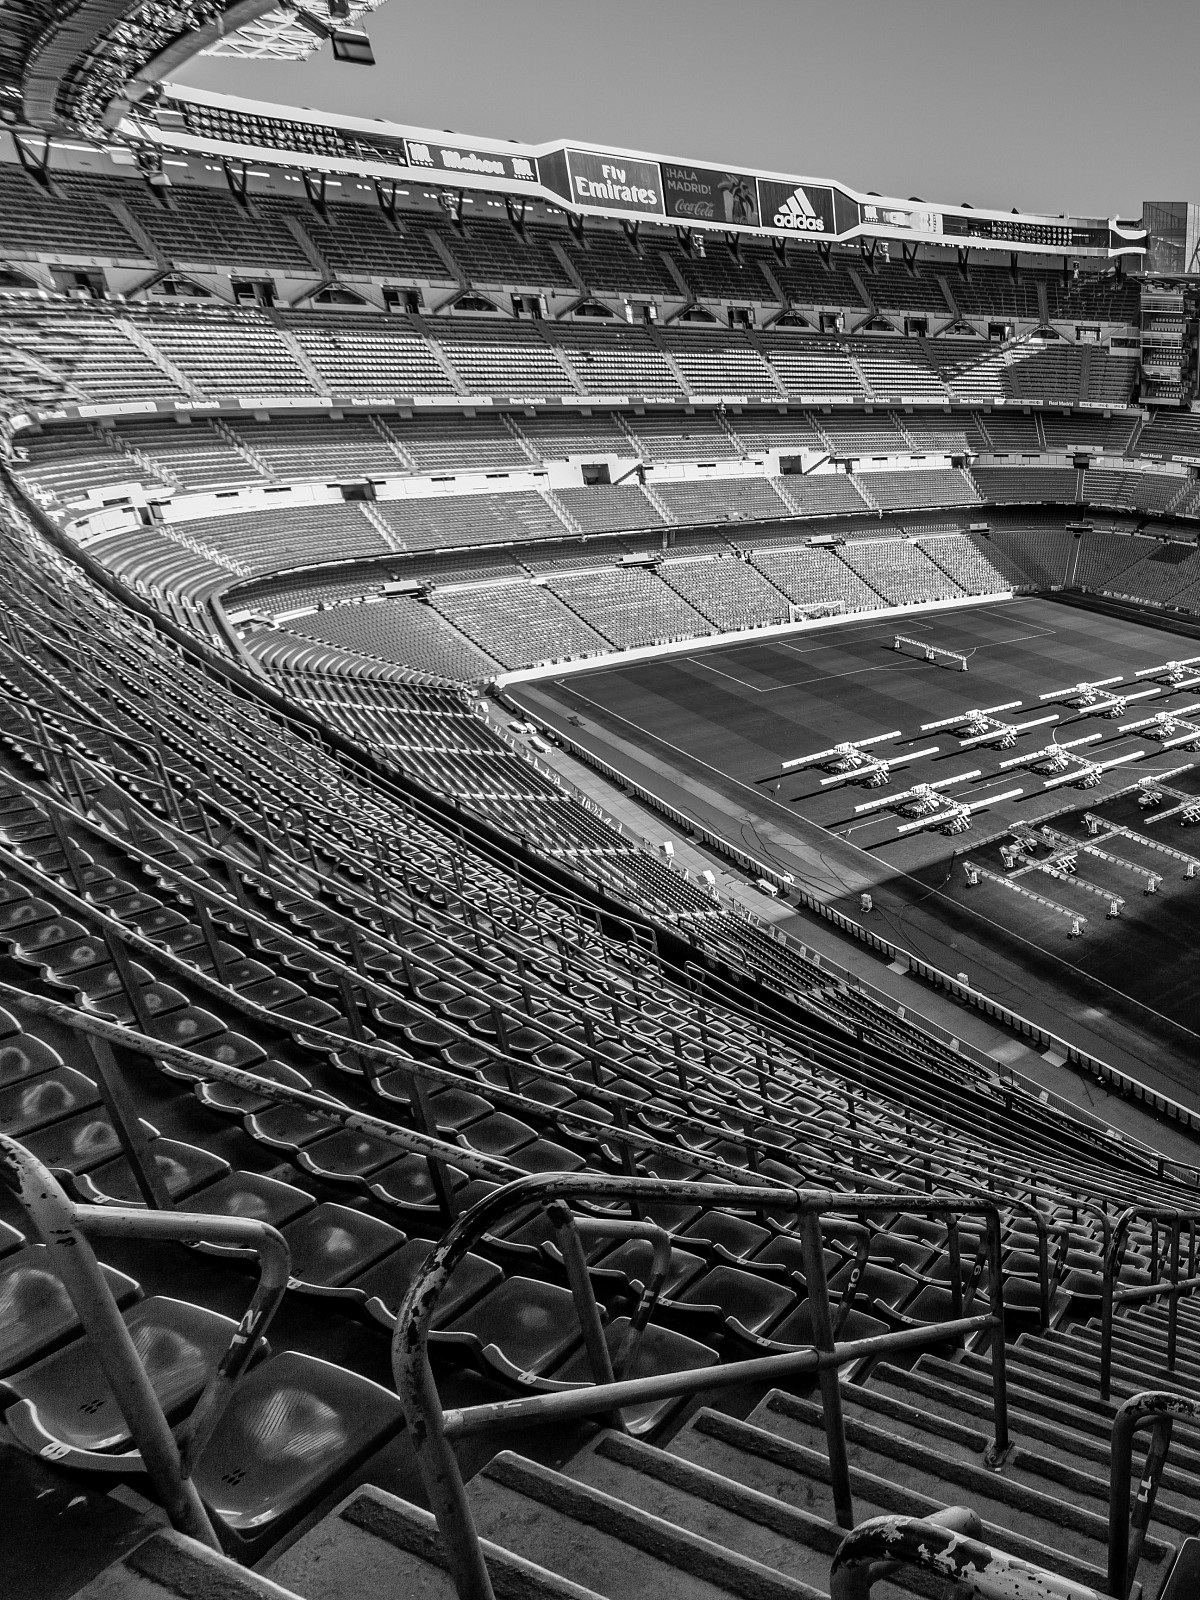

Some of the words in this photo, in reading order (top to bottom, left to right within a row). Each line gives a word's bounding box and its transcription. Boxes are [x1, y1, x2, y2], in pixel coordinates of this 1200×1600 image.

[602, 164, 626, 183] Fly
[575, 176, 658, 205] Emirates
[667, 180, 712, 195] MADRID!
[773, 213, 825, 231] adidas
